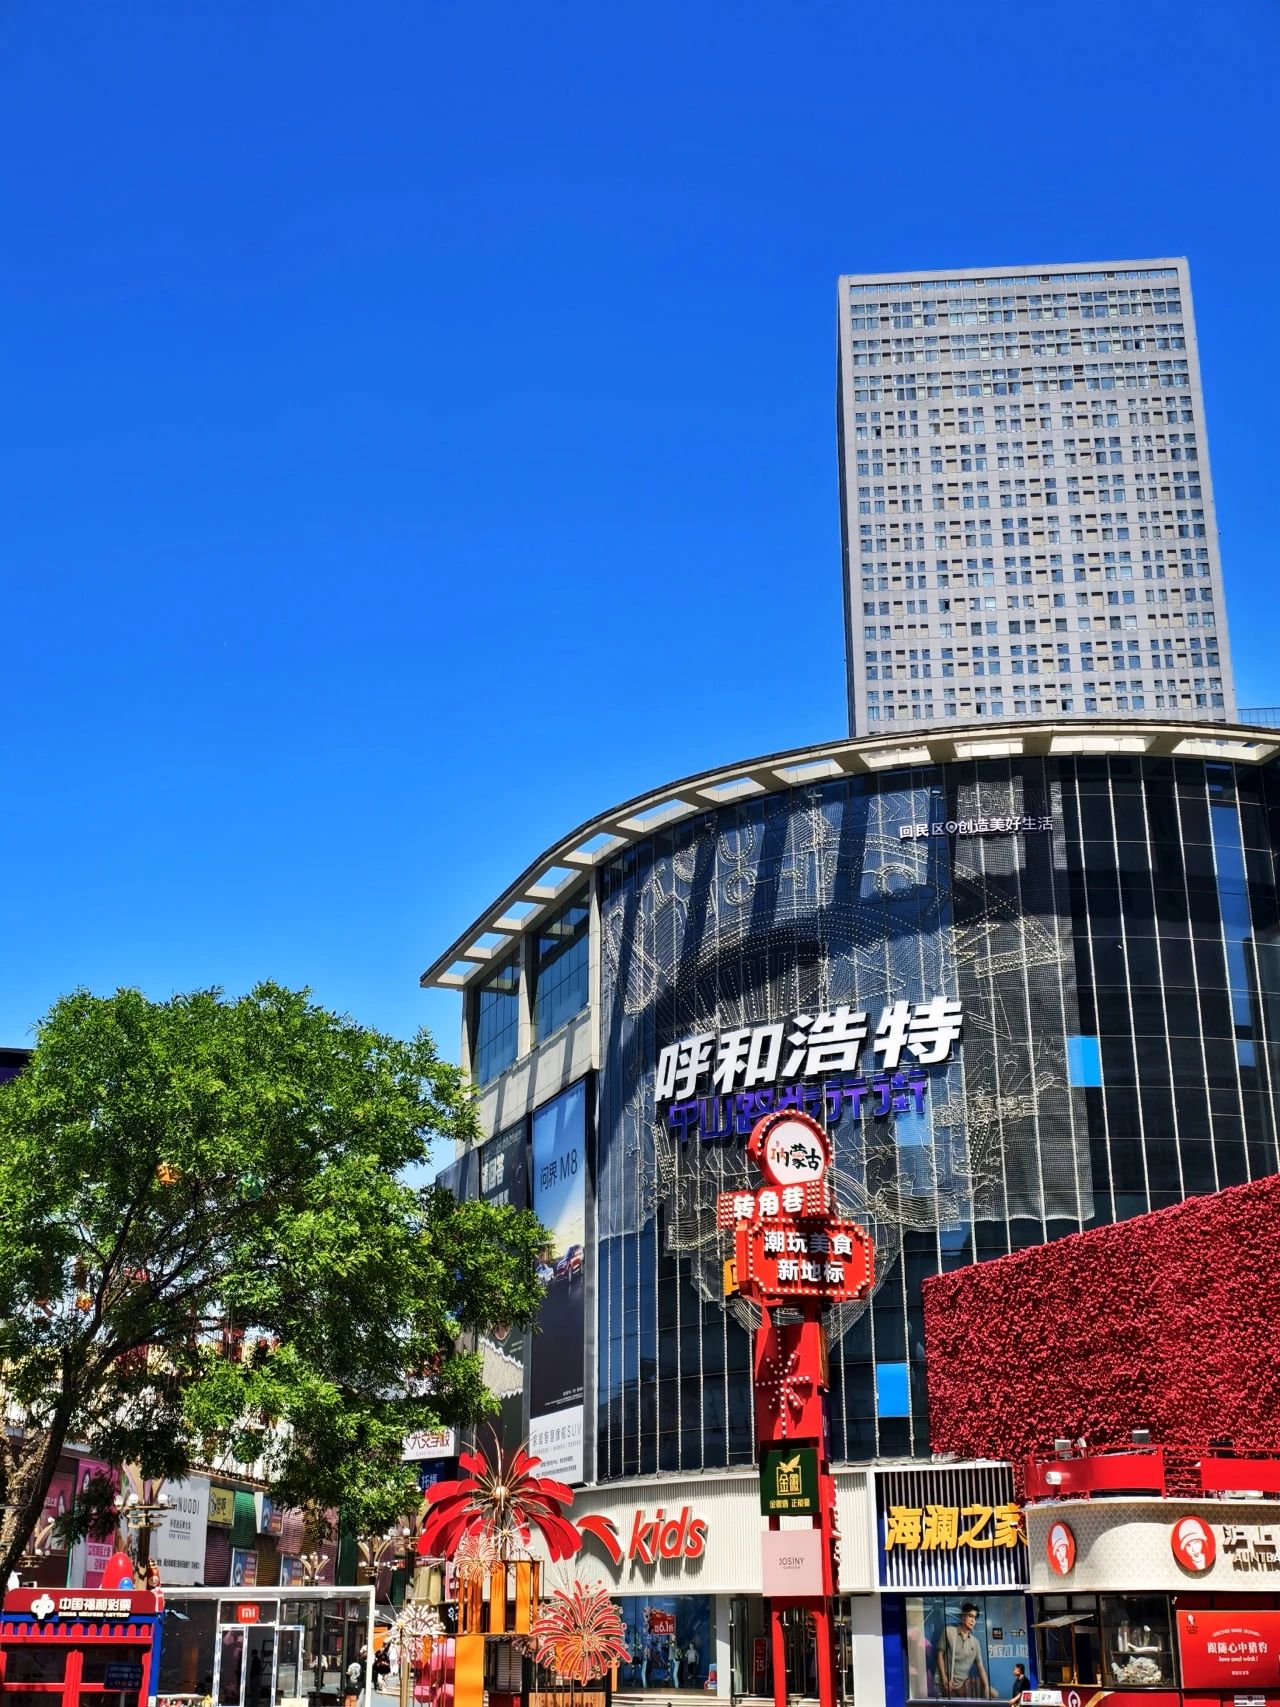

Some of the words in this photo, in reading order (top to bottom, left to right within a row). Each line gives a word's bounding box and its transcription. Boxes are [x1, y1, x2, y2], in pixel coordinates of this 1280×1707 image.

[900, 822, 945, 839] 回民区
[958, 816, 1054, 834] 创造美好生活
[654, 997, 963, 1103] 呼和浩特
[540, 1160, 559, 1193] 问界
[560, 1148, 578, 1182] M8
[733, 1186, 805, 1221] 转角巷
[764, 1230, 853, 1256] 潮玩美食
[777, 1259, 845, 1283] 新地标
[628, 1505, 708, 1565] kids
[884, 1502, 1028, 1551] 海澜之家
[779, 1557, 805, 1566] JOSINY
[58, 1598, 132, 1611] 中国福利彩票
